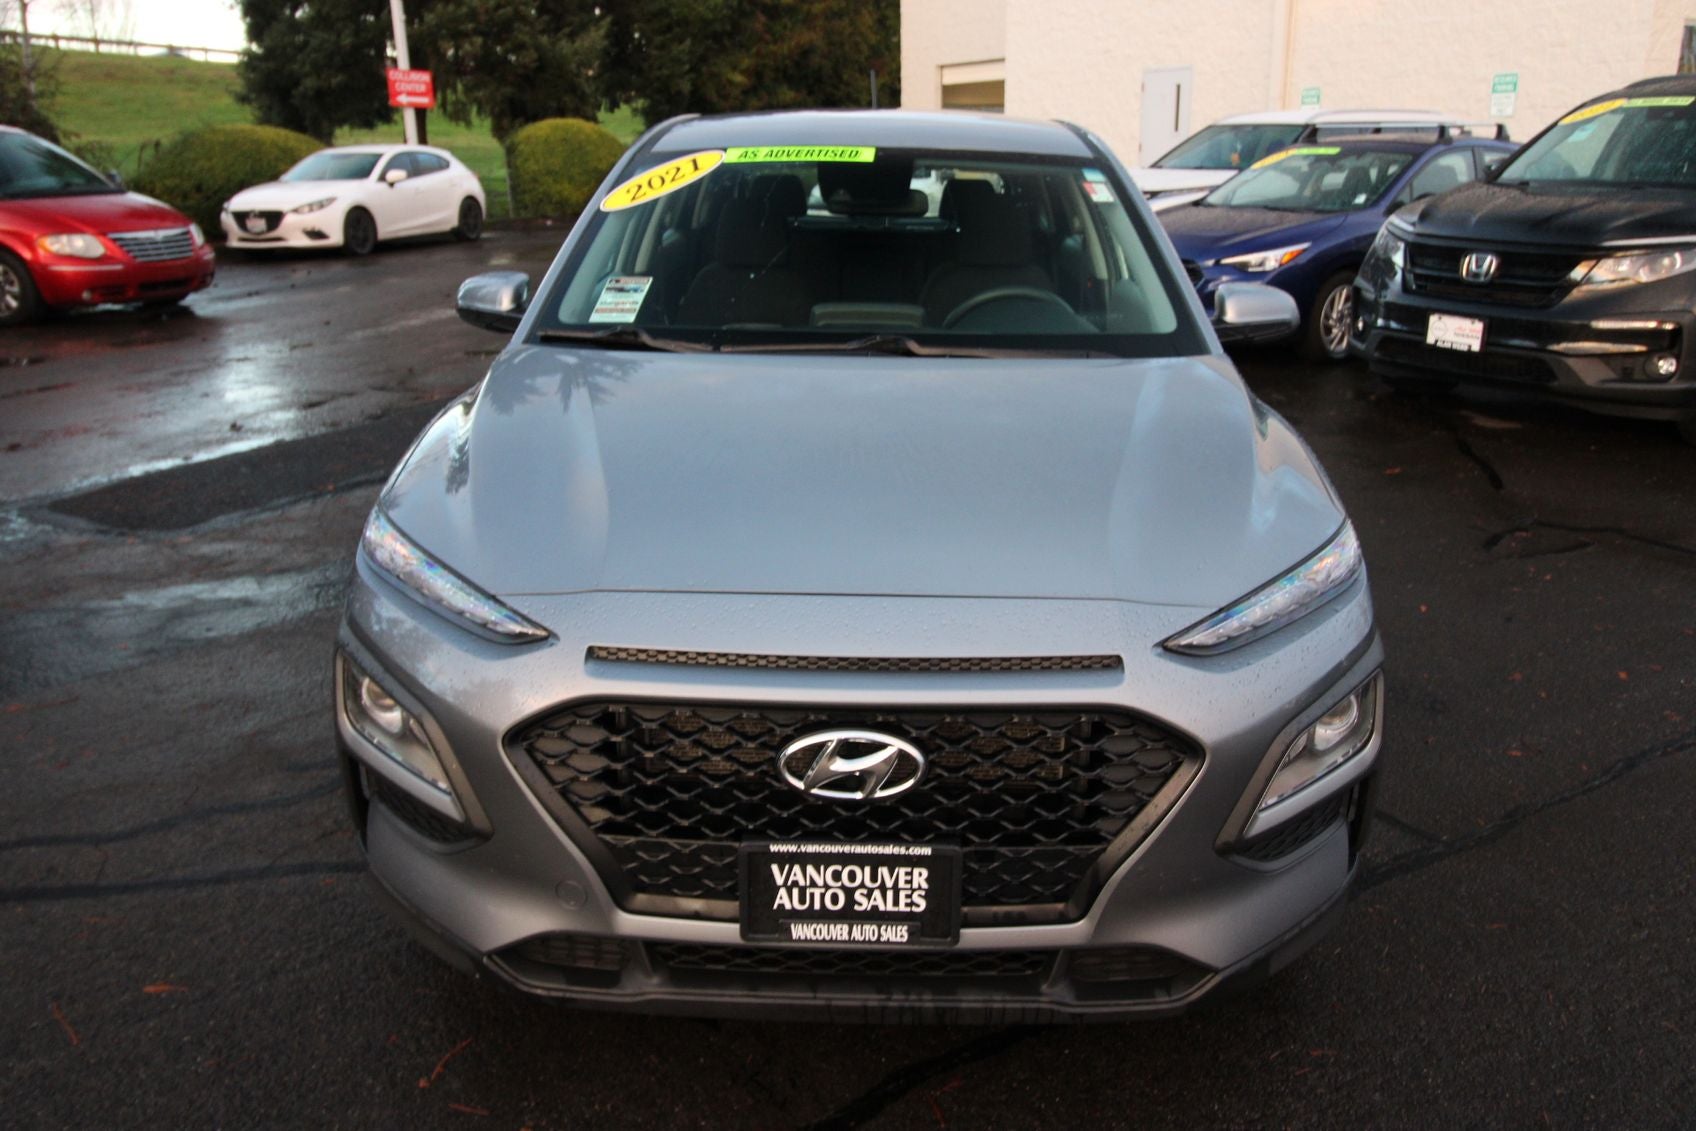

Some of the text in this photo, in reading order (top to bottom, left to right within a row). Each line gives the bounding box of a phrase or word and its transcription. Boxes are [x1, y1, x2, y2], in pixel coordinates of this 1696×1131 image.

[738, 148, 861, 160] AS ADVERTISED
[625, 158, 702, 203] 2021
[769, 843, 932, 856] www.vancouverautosales.com
[771, 863, 929, 889] VANCOUVER
[773, 887, 927, 912] AUTO SALES
[791, 923, 908, 942] VANCOUVER AUTO SALES
